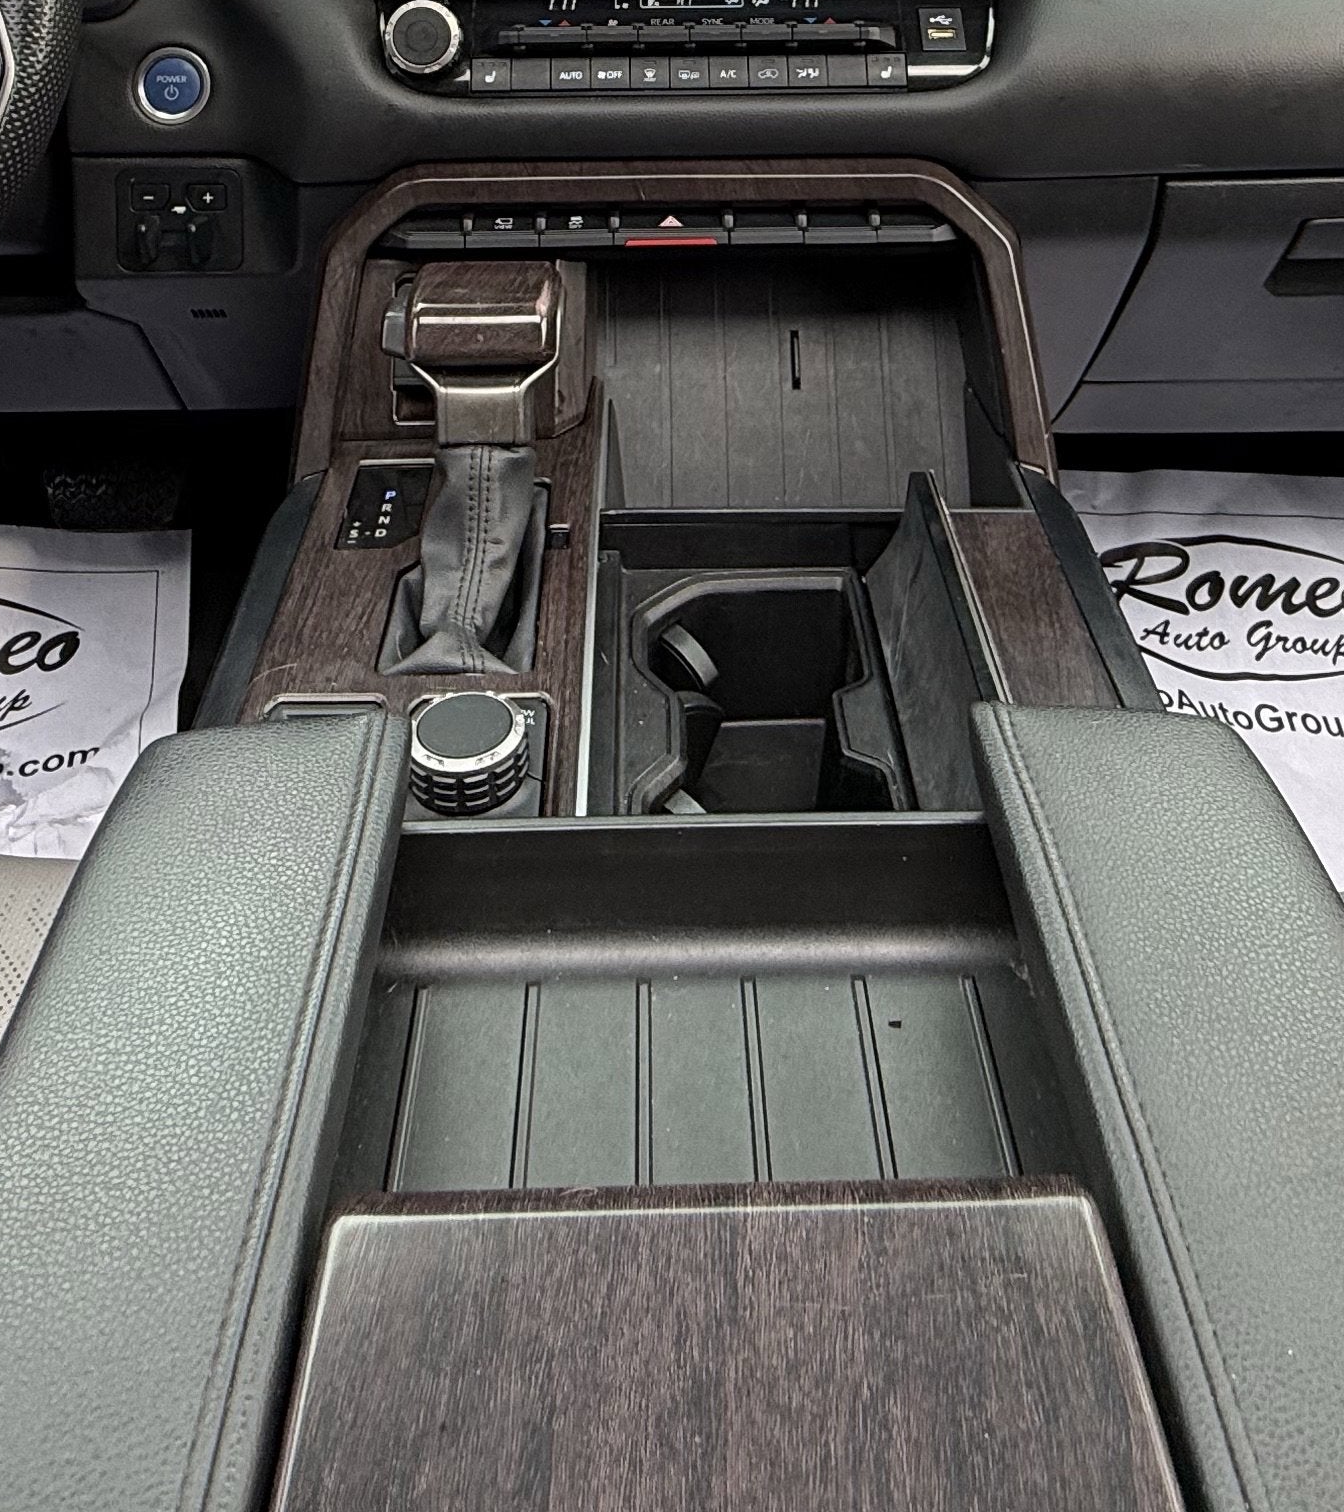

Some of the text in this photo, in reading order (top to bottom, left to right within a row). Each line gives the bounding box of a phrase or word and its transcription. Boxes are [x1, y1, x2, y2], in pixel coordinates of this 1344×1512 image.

[650, 18, 675, 26] REAR
[701, 18, 724, 26] SYNC
[750, 17, 775, 25] MODE
[156, 74, 187, 84] POWER
[559, 71, 583, 80] AUTO
[607, 70, 623, 79] OFF
[719, 69, 737, 80] A/C
[384, 490, 397, 500] P
[381, 503, 393, 513] R
[378, 515, 391, 525] N
[349, 528, 387, 538] S D
[1140, 619, 1231, 652] Auto
